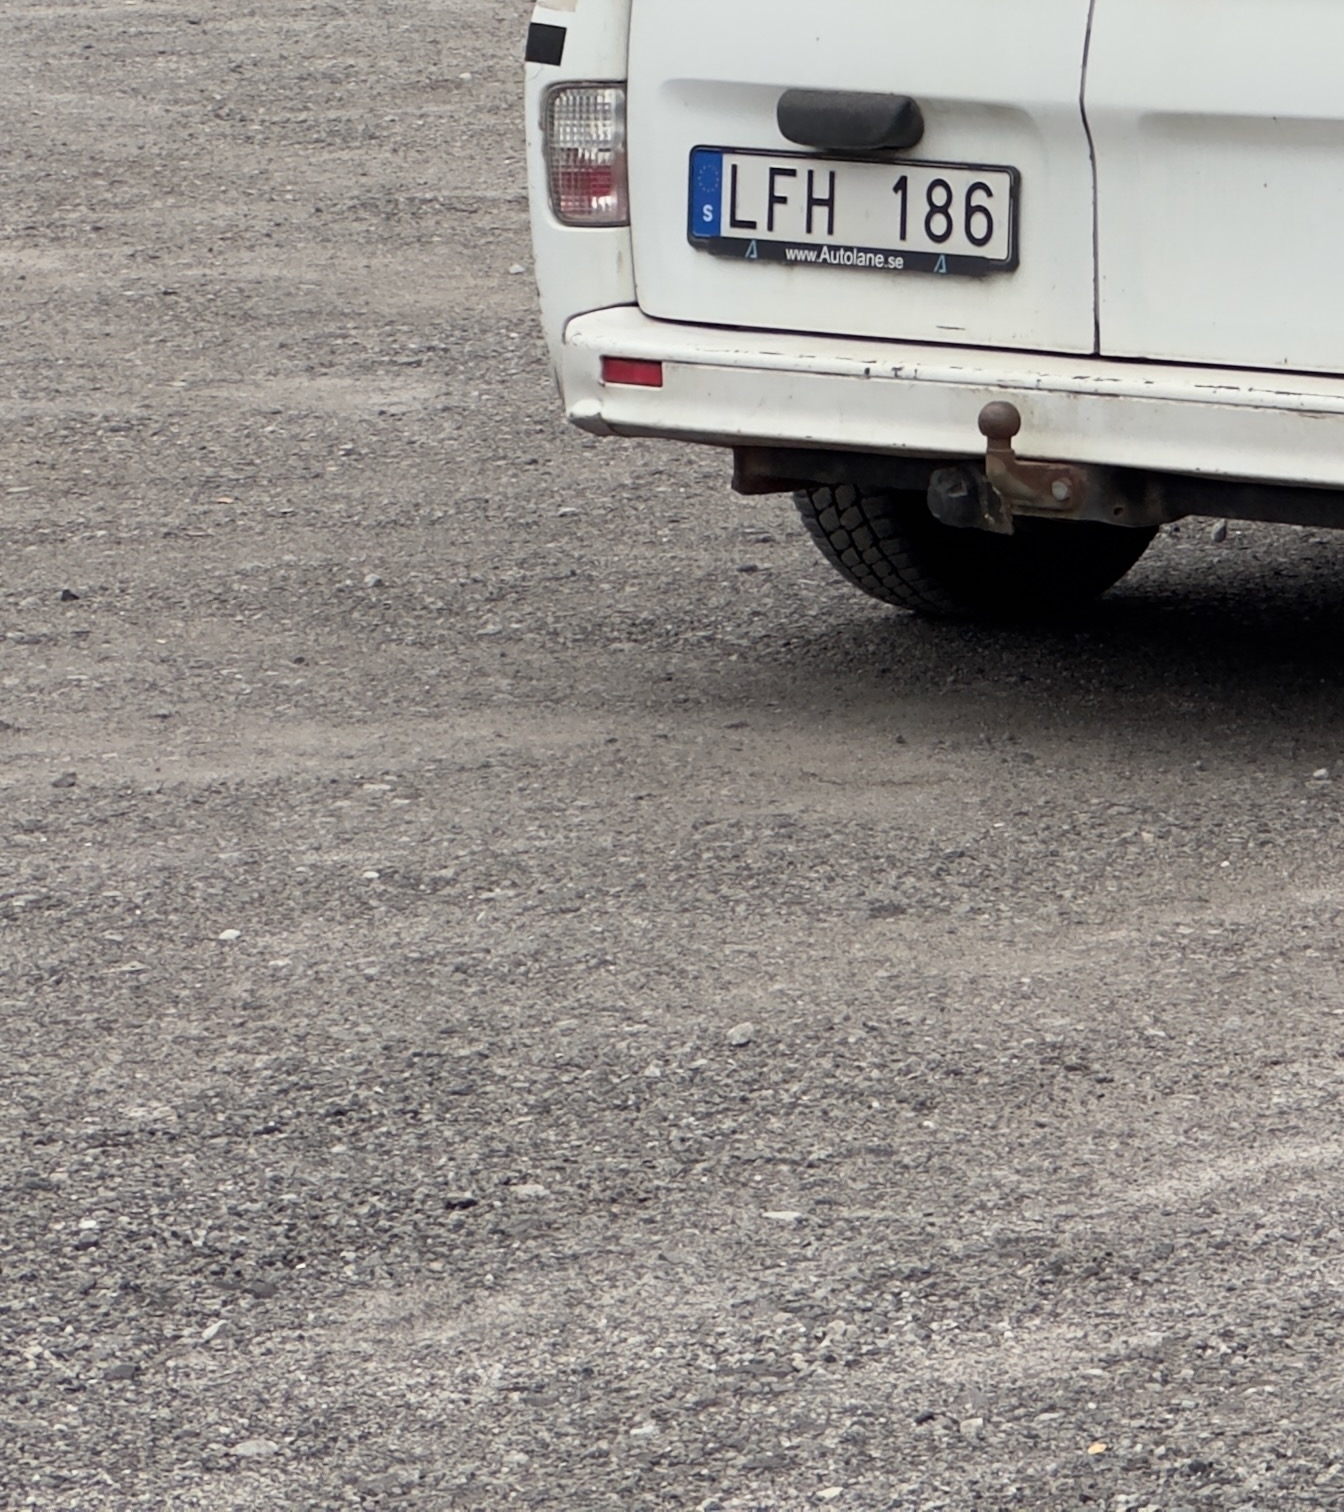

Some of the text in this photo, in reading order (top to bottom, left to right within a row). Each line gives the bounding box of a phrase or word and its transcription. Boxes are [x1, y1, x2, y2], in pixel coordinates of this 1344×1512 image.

[702, 204, 714, 222] S
[730, 163, 994, 248] LFH 186
[785, 245, 904, 269] www.Autolane.se
